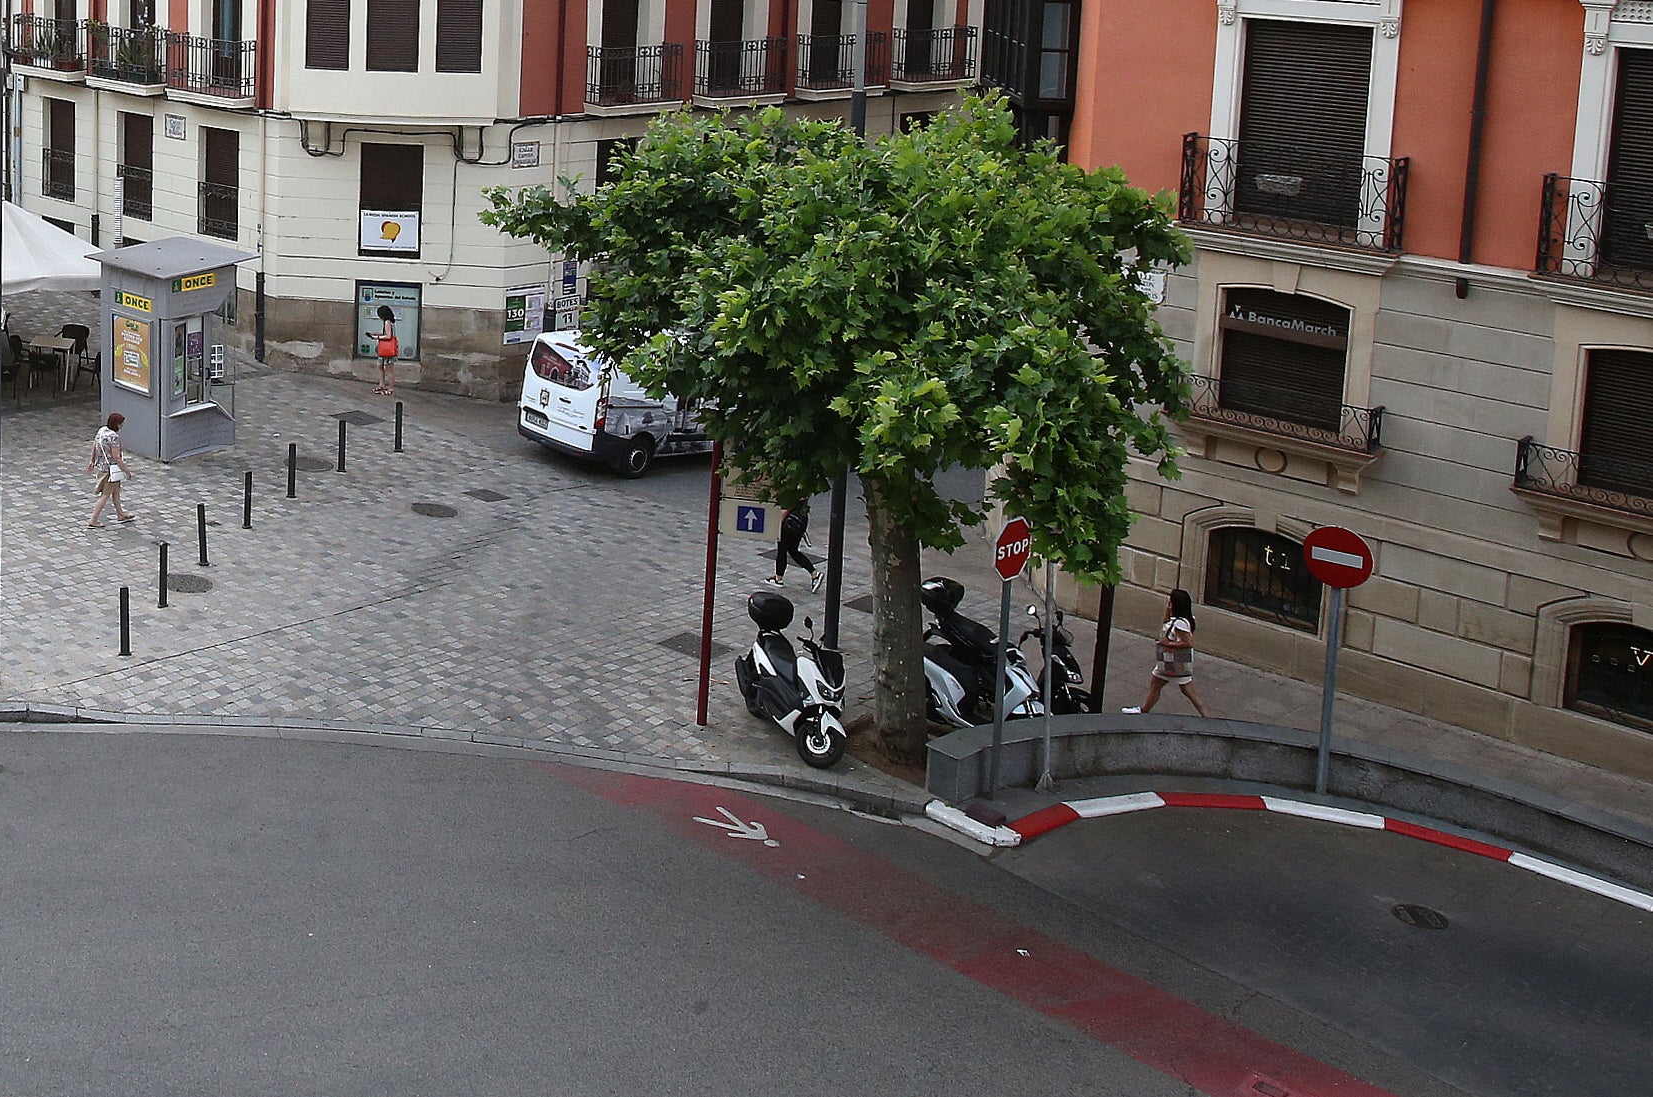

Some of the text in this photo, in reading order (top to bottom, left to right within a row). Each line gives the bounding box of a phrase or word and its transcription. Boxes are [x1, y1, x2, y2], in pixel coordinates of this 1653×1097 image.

[185, 275, 213, 289] ONCE
[124, 297, 150, 310] ONCE
[556, 298, 579, 308] BOTES
[507, 308, 524, 318] 130
[1247, 311, 1337, 337] BancaMarch
[997, 537, 1030, 561] STOP
